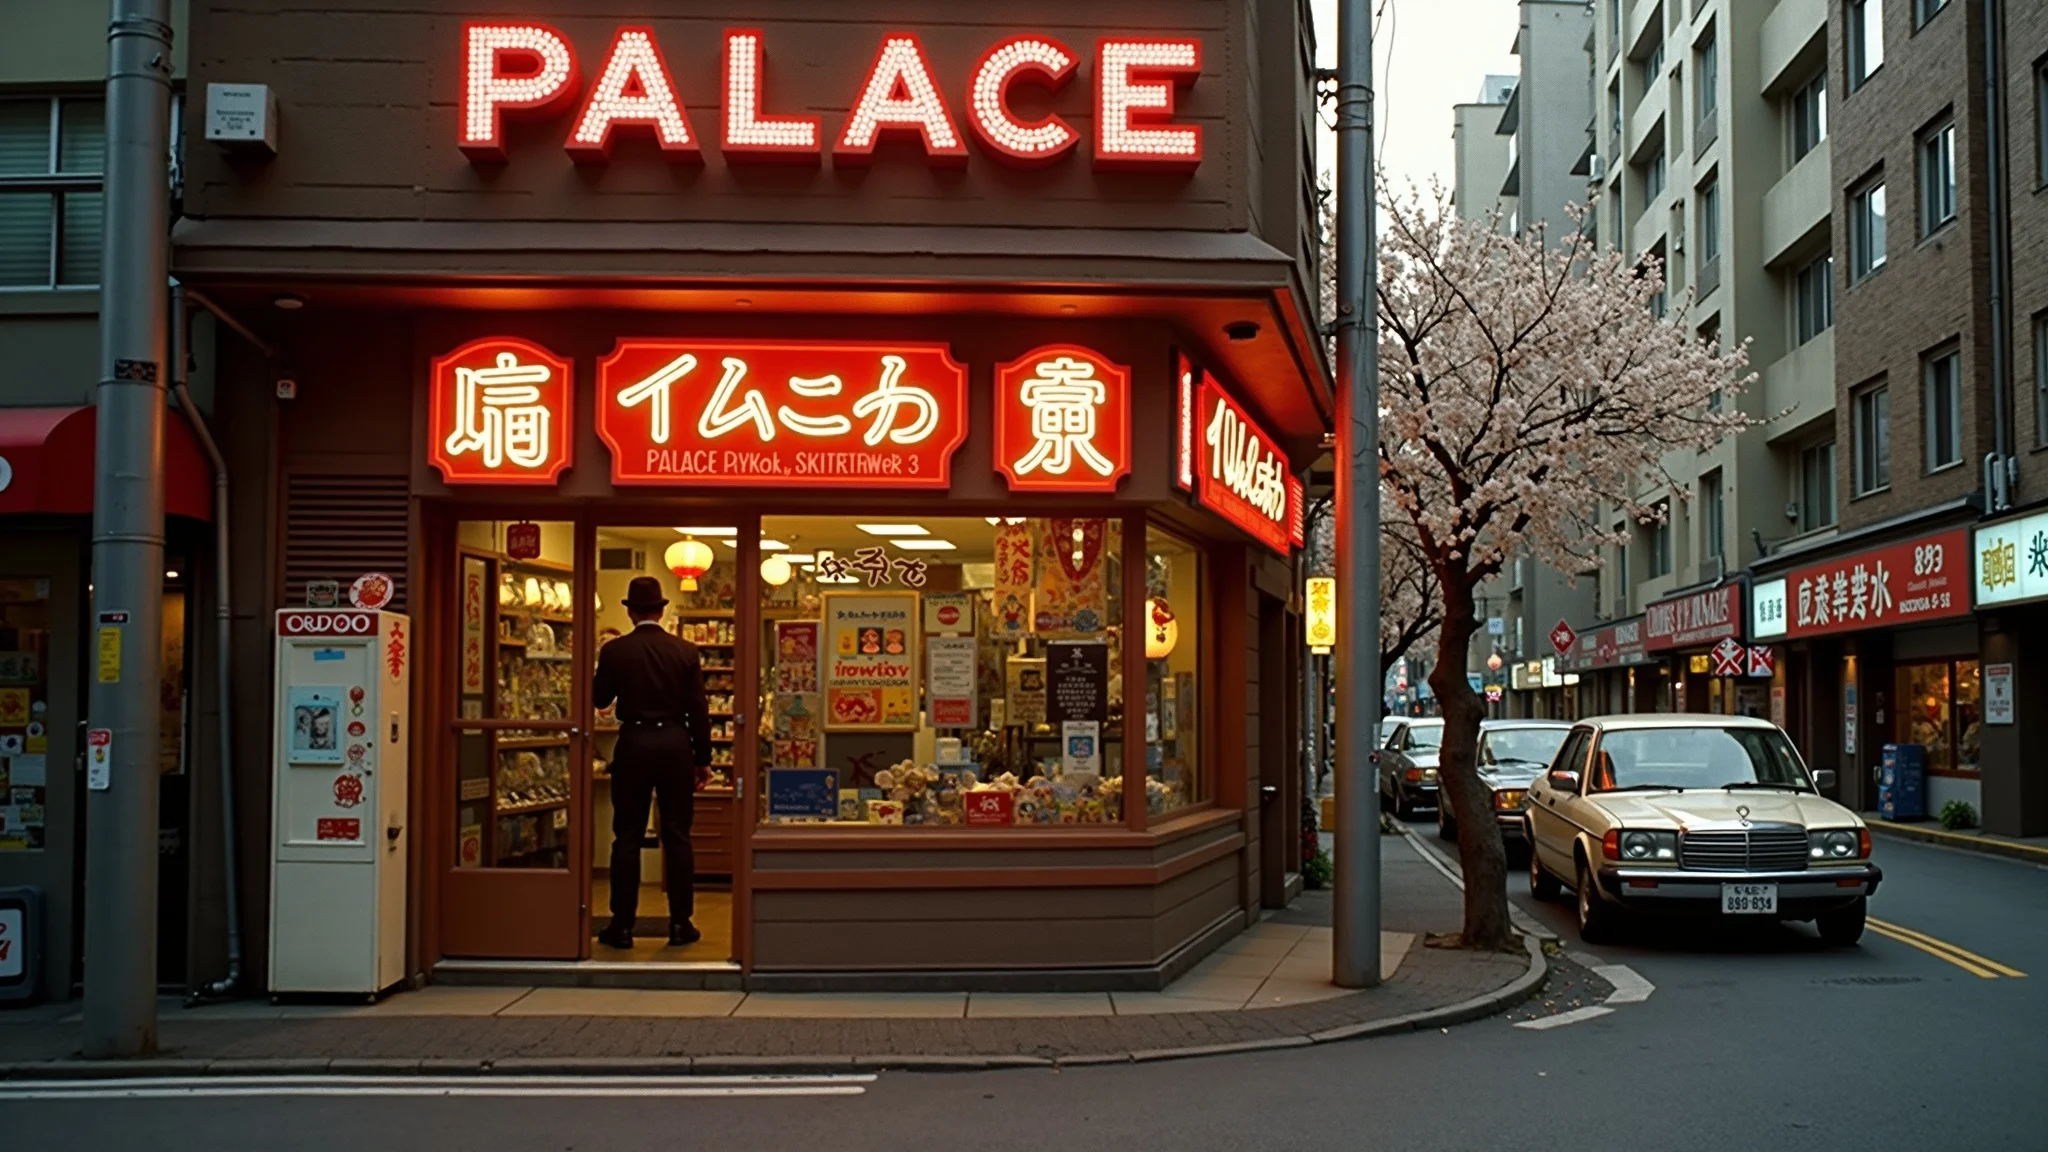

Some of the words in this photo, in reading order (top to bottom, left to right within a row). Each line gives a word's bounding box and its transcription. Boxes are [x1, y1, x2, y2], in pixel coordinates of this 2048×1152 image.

[459, 21, 1202, 168] PALACE
[646, 450, 717, 474] PALACE
[908, 454, 919, 475] 3
